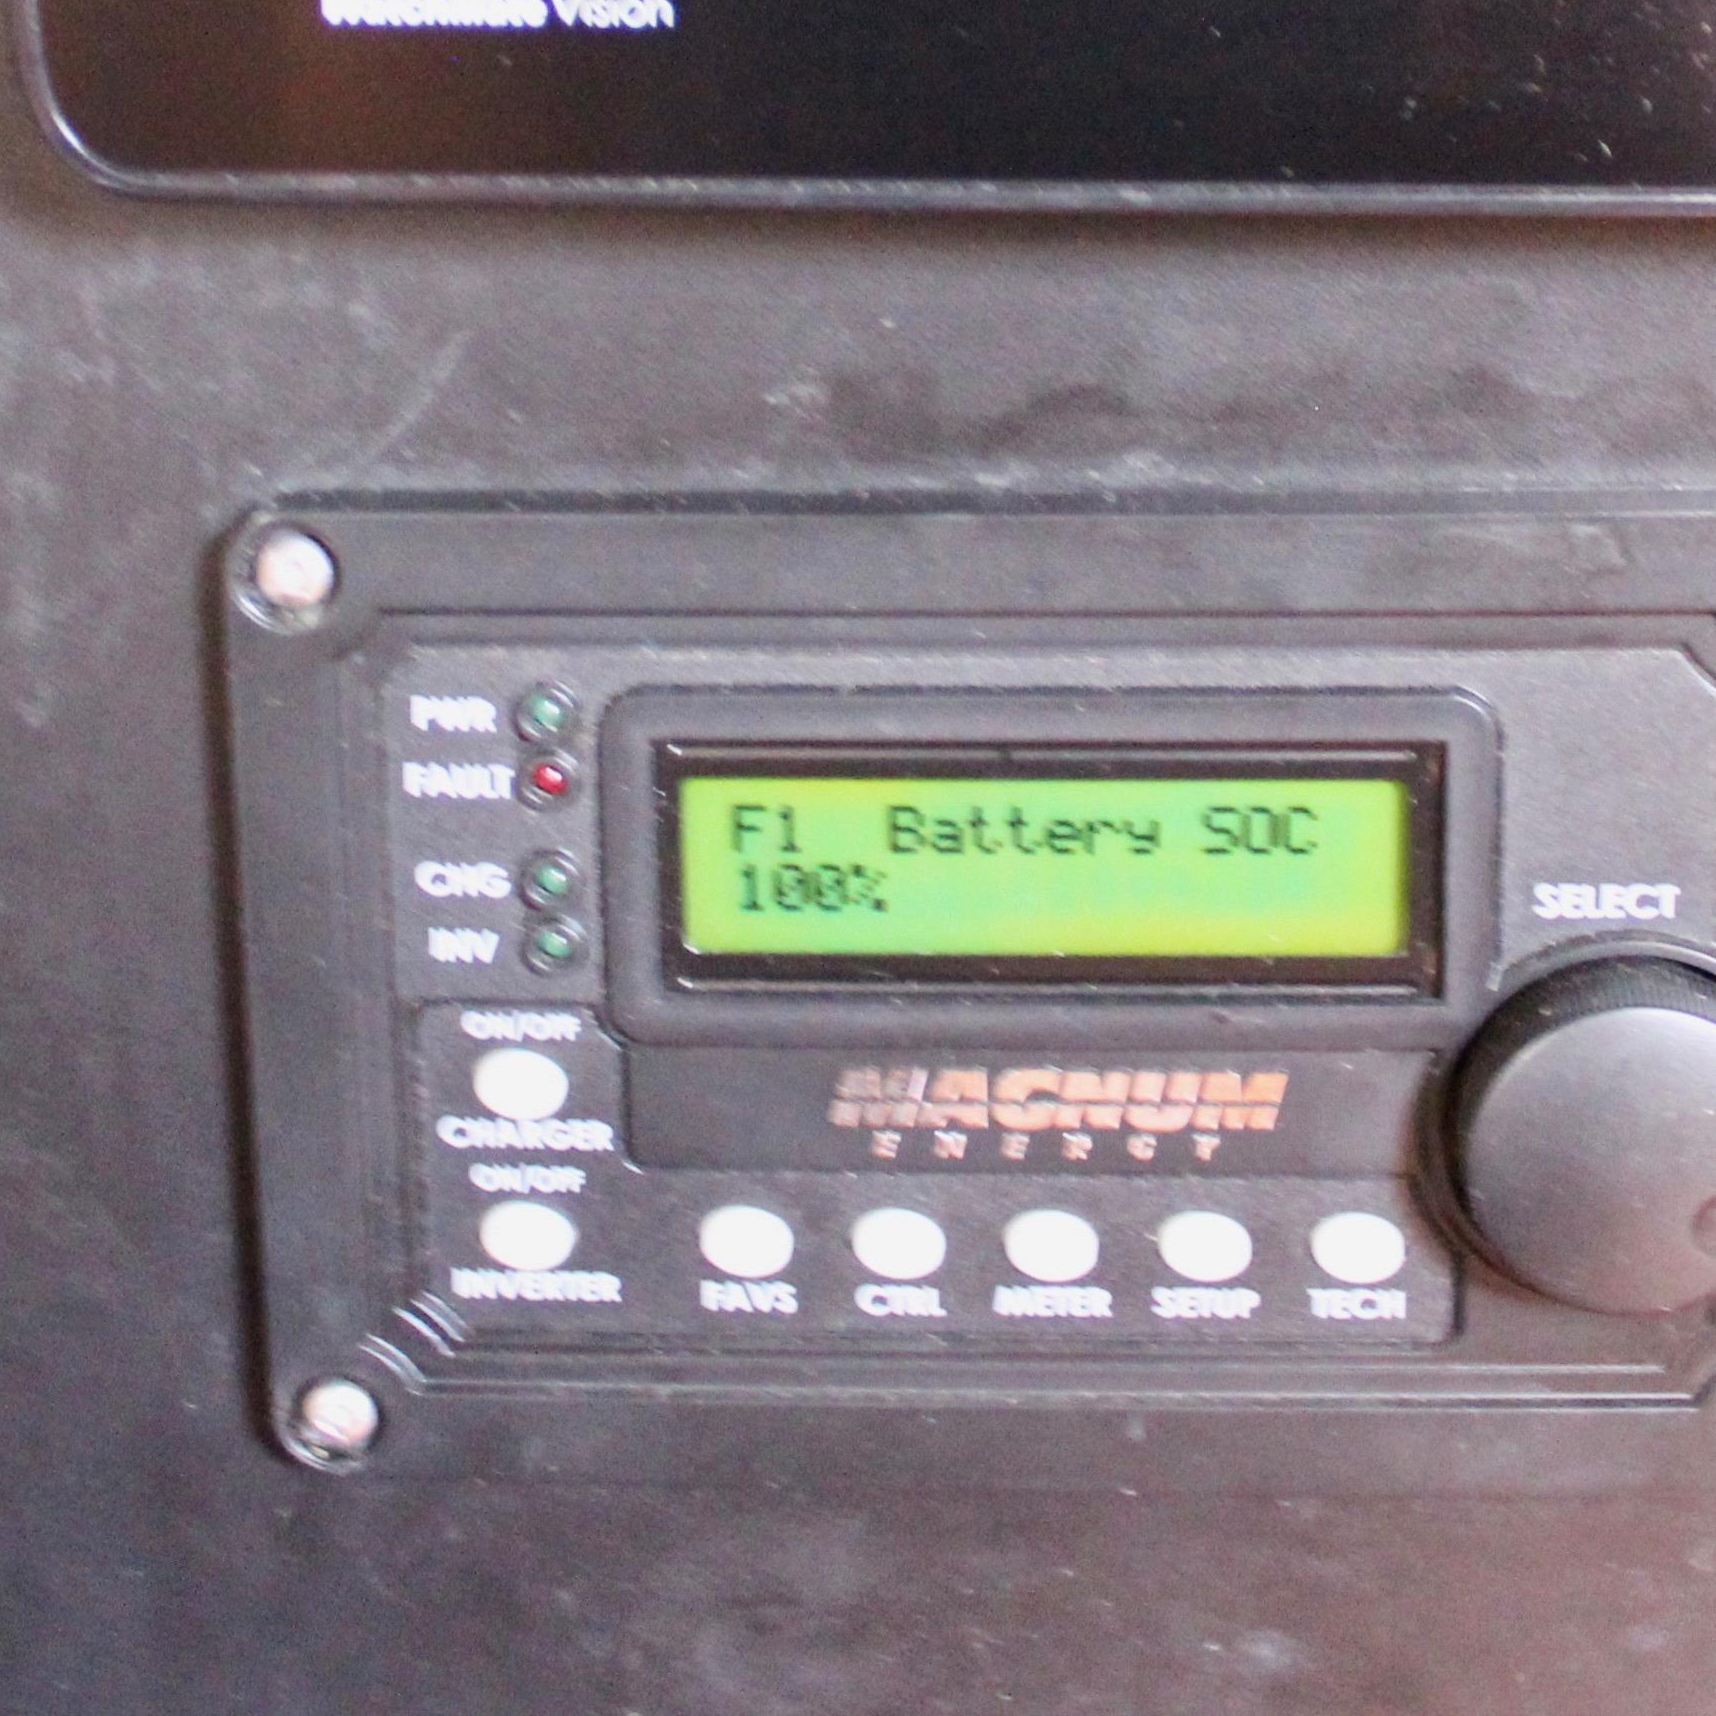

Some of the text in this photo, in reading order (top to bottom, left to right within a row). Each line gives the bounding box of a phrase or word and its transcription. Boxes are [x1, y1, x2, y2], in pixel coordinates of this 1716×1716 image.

[409, 695, 497, 732] PWR
[402, 761, 515, 799] FAULT
[730, 803, 1319, 857] F1 Battery SOC
[740, 862, 890, 913] 100%
[1532, 882, 1682, 919] SELECT
[427, 927, 500, 964] INV
[460, 1009, 582, 1041] ON/OFF
[829, 1066, 1288, 1131] MAGNUM
[436, 1115, 614, 1150] CHARGER
[468, 1163, 586, 1193] ON/OFF
[450, 1267, 623, 1302] INVERTER
[699, 1280, 798, 1313] FAVS
[854, 1283, 948, 1316] CTRL
[992, 1284, 1113, 1318] METER
[1150, 1286, 1261, 1319] SETUP
[1306, 1287, 1406, 1320] TECH
